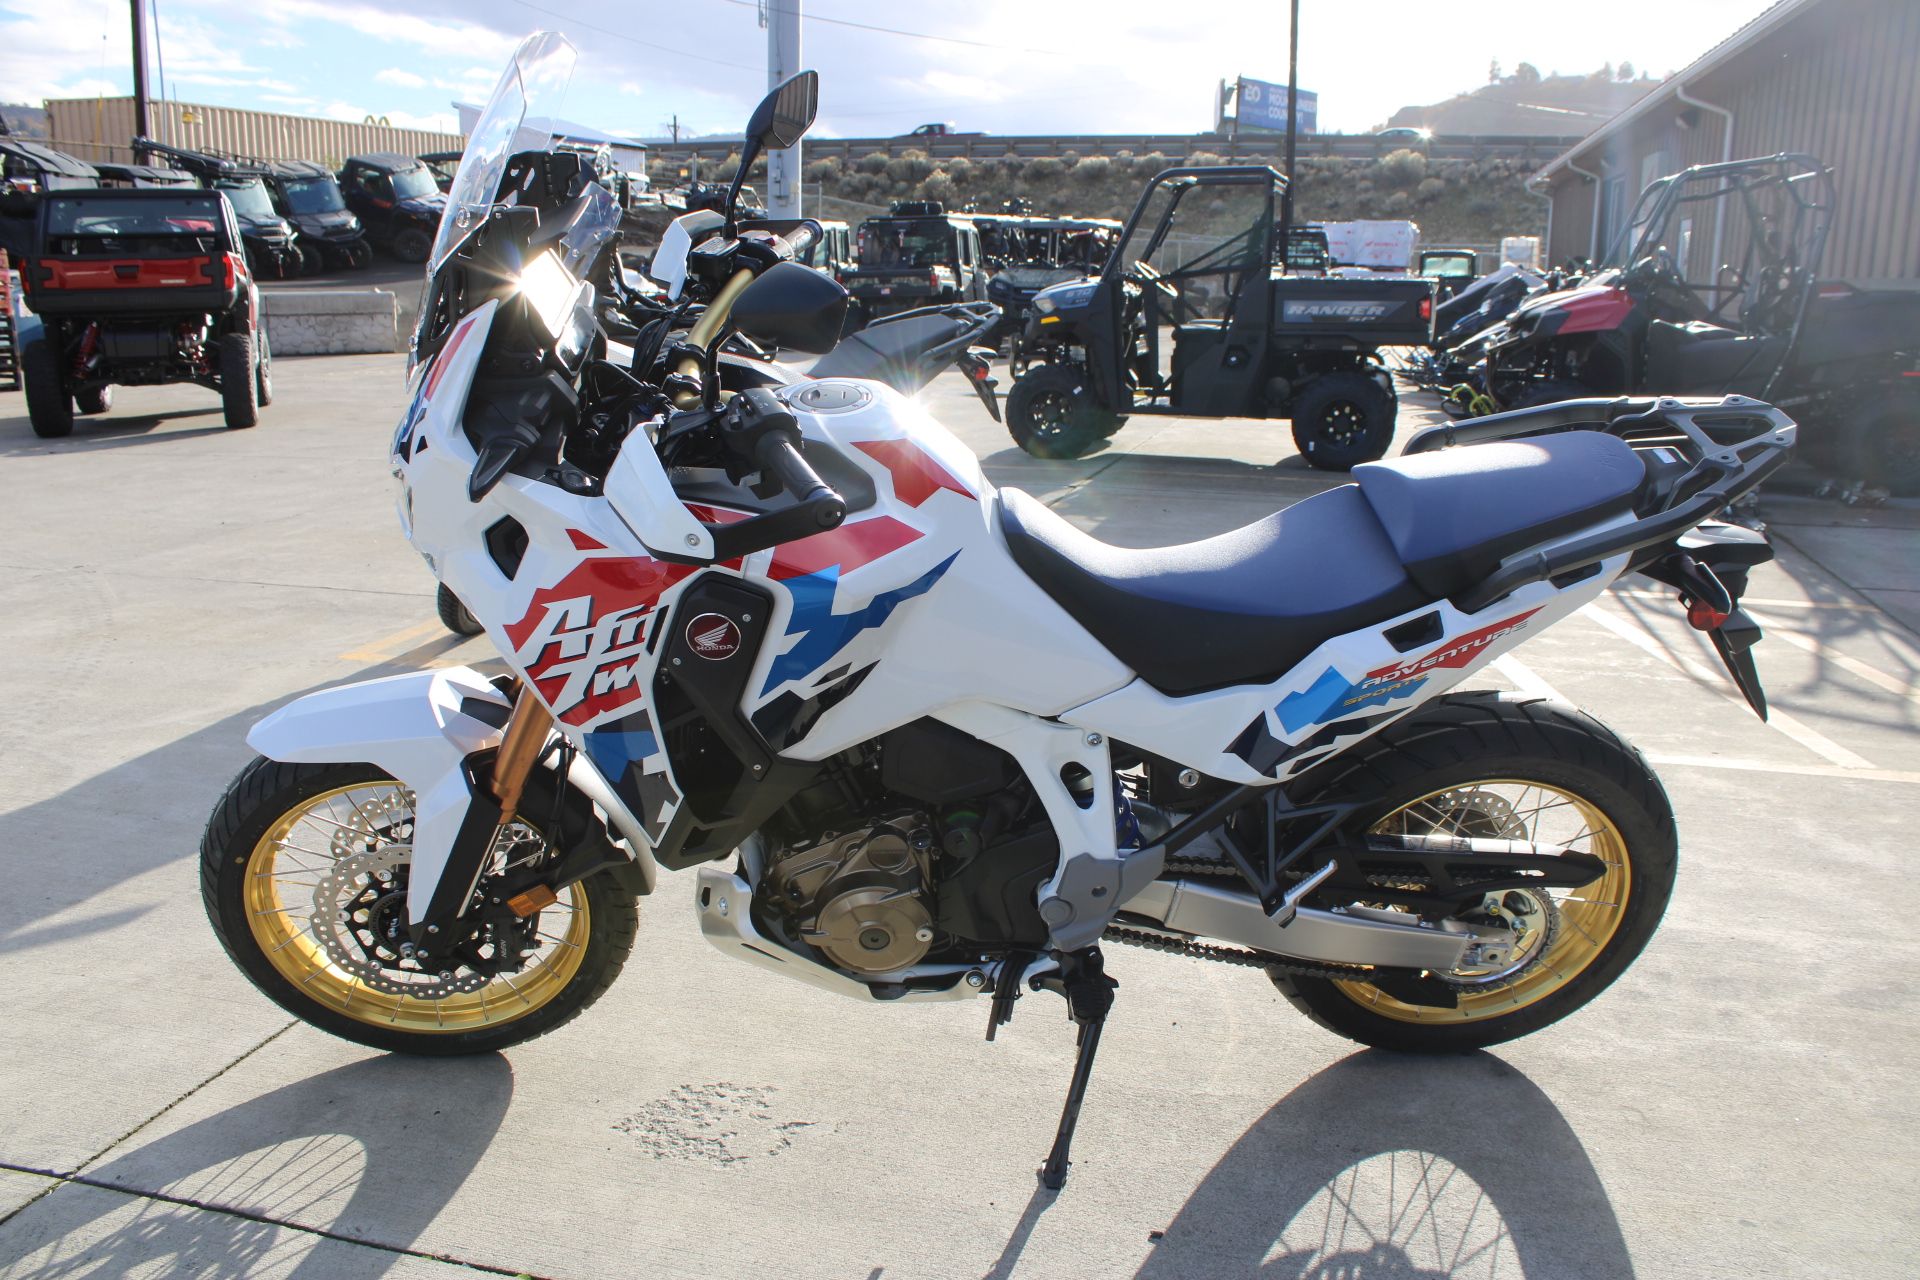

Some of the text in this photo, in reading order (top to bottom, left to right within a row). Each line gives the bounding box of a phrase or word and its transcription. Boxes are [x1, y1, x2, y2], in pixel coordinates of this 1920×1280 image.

[1267, 106, 1304, 123] COUNY!
[1287, 305, 1385, 316] RANGER
[1361, 620, 1528, 690] ADVENTURE
[1343, 672, 1428, 707] SPORTS
